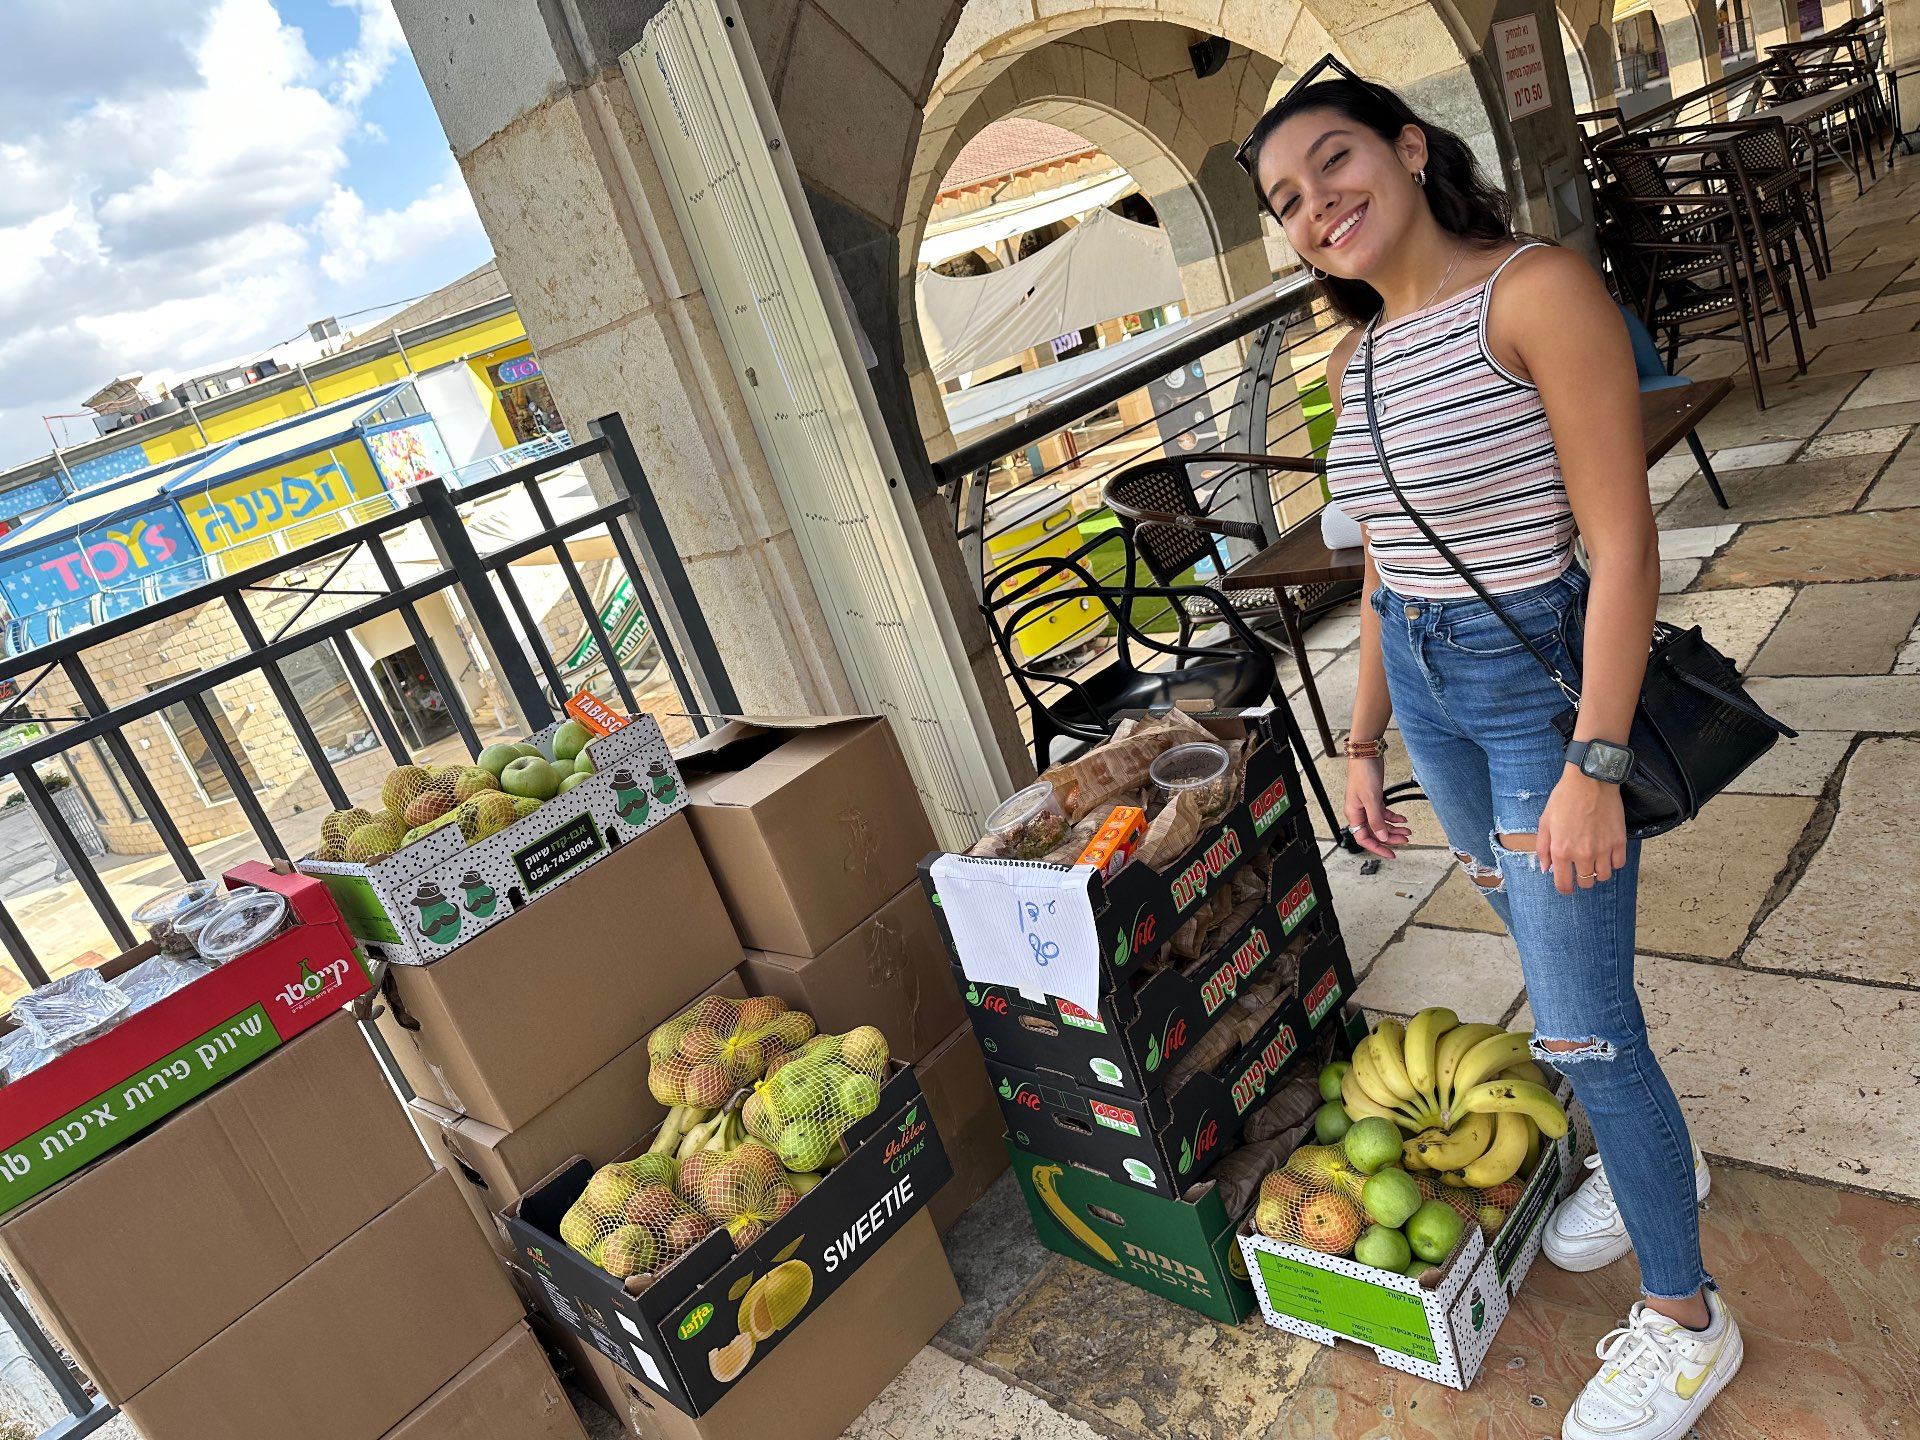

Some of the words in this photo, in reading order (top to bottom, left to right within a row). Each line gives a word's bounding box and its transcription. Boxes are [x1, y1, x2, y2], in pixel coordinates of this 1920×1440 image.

[1532, 83, 1543, 101] 50
[506, 357, 540, 379] TO
[197, 461, 357, 544] הפנינה
[40, 520, 177, 591] TOYS
[575, 694, 623, 734] TABASC
[524, 846, 550, 870] שיווק
[529, 836, 594, 881] 054-7438004
[275, 959, 349, 1006] קייסטר
[194, 1013, 263, 1071] שיווק
[122, 1059, 191, 1111] פירות
[39, 1102, 118, 1161] איכות
[890, 1137, 925, 1174] Citrus
[823, 1174, 915, 1274] SWEETIE
[1122, 1240, 1208, 1285] בננות
[1131, 1260, 1212, 1299] איכות
[680, 1305, 714, 1338] Jaffa
[1407, 1297, 1421, 1306] שם
